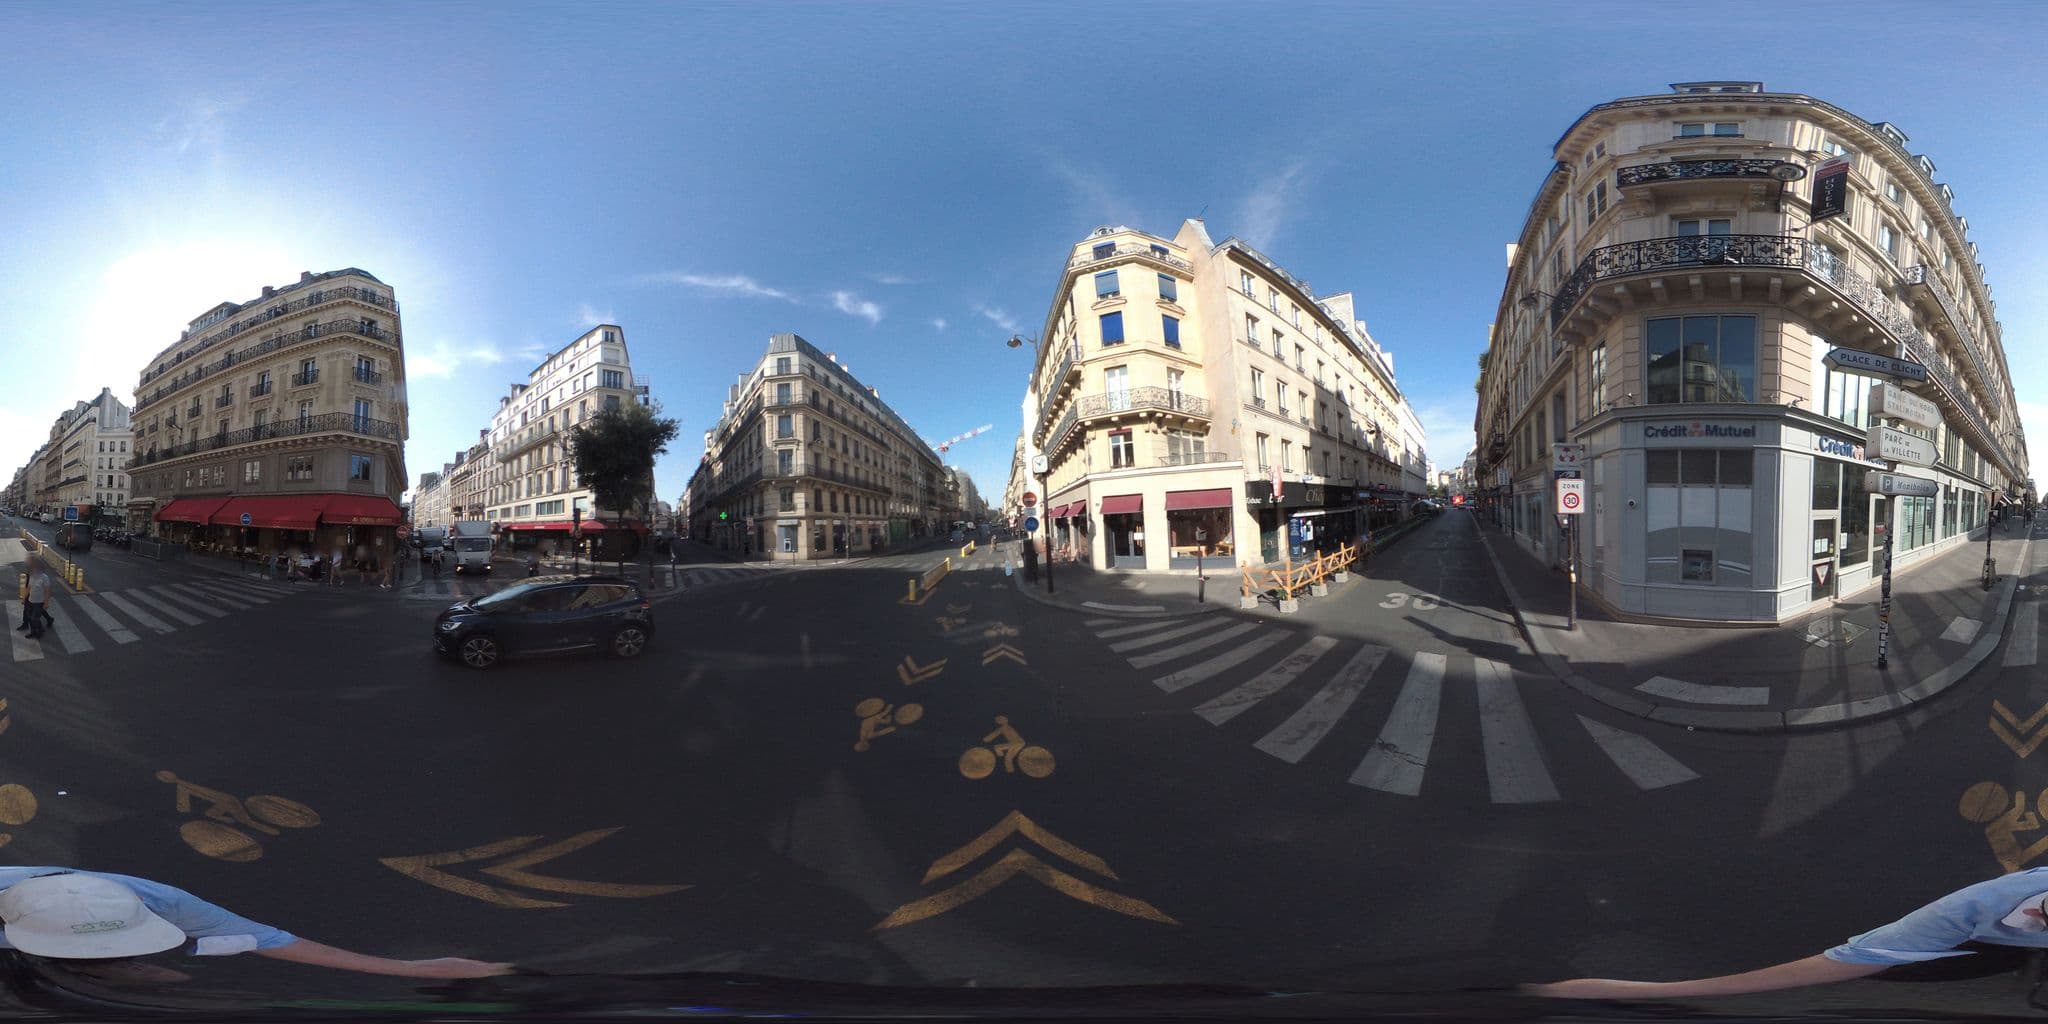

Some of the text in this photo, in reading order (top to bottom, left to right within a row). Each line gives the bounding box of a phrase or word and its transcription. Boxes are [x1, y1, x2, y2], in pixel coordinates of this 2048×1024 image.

[1825, 177, 1835, 208] HOTEL
[1840, 353, 1922, 376] PLACE DE CLICHY
[1645, 424, 1756, 438] Crédit Mutuel
[1884, 433, 1903, 445] PARC
[1819, 435, 1853, 458] Crédit
[1892, 447, 1921, 460] VILLETTE
[1566, 497, 1577, 505] 30
[1378, 592, 1441, 610] 30
